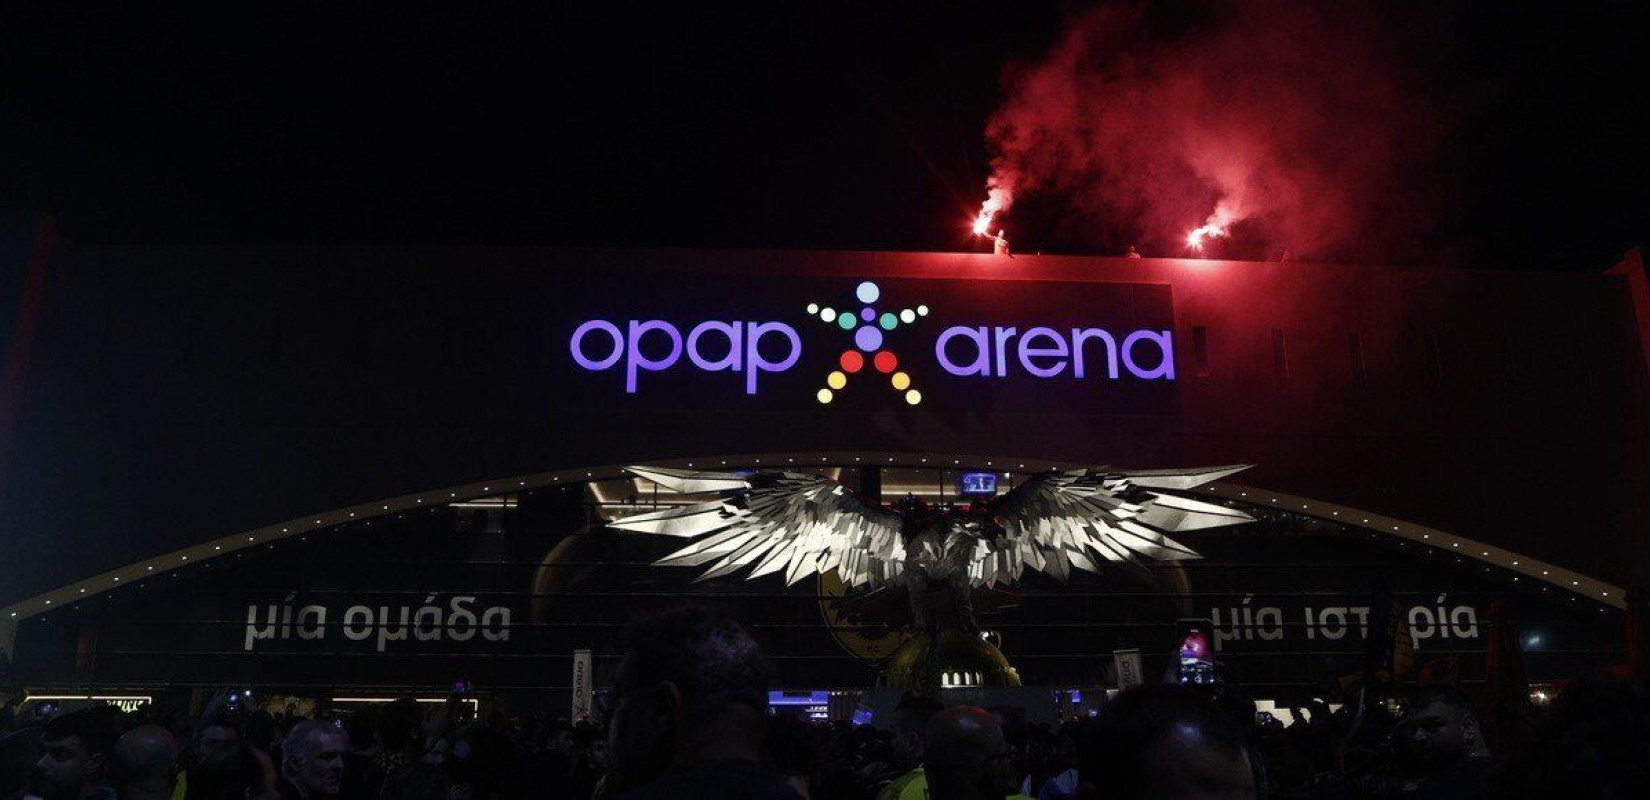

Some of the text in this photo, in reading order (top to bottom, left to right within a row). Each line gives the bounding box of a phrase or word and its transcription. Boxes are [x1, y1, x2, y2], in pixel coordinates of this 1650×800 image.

[569, 319, 1175, 395] opap arena
[244, 591, 512, 651] μία ομάδα
[1212, 593, 1480, 652] μία ιστρία
